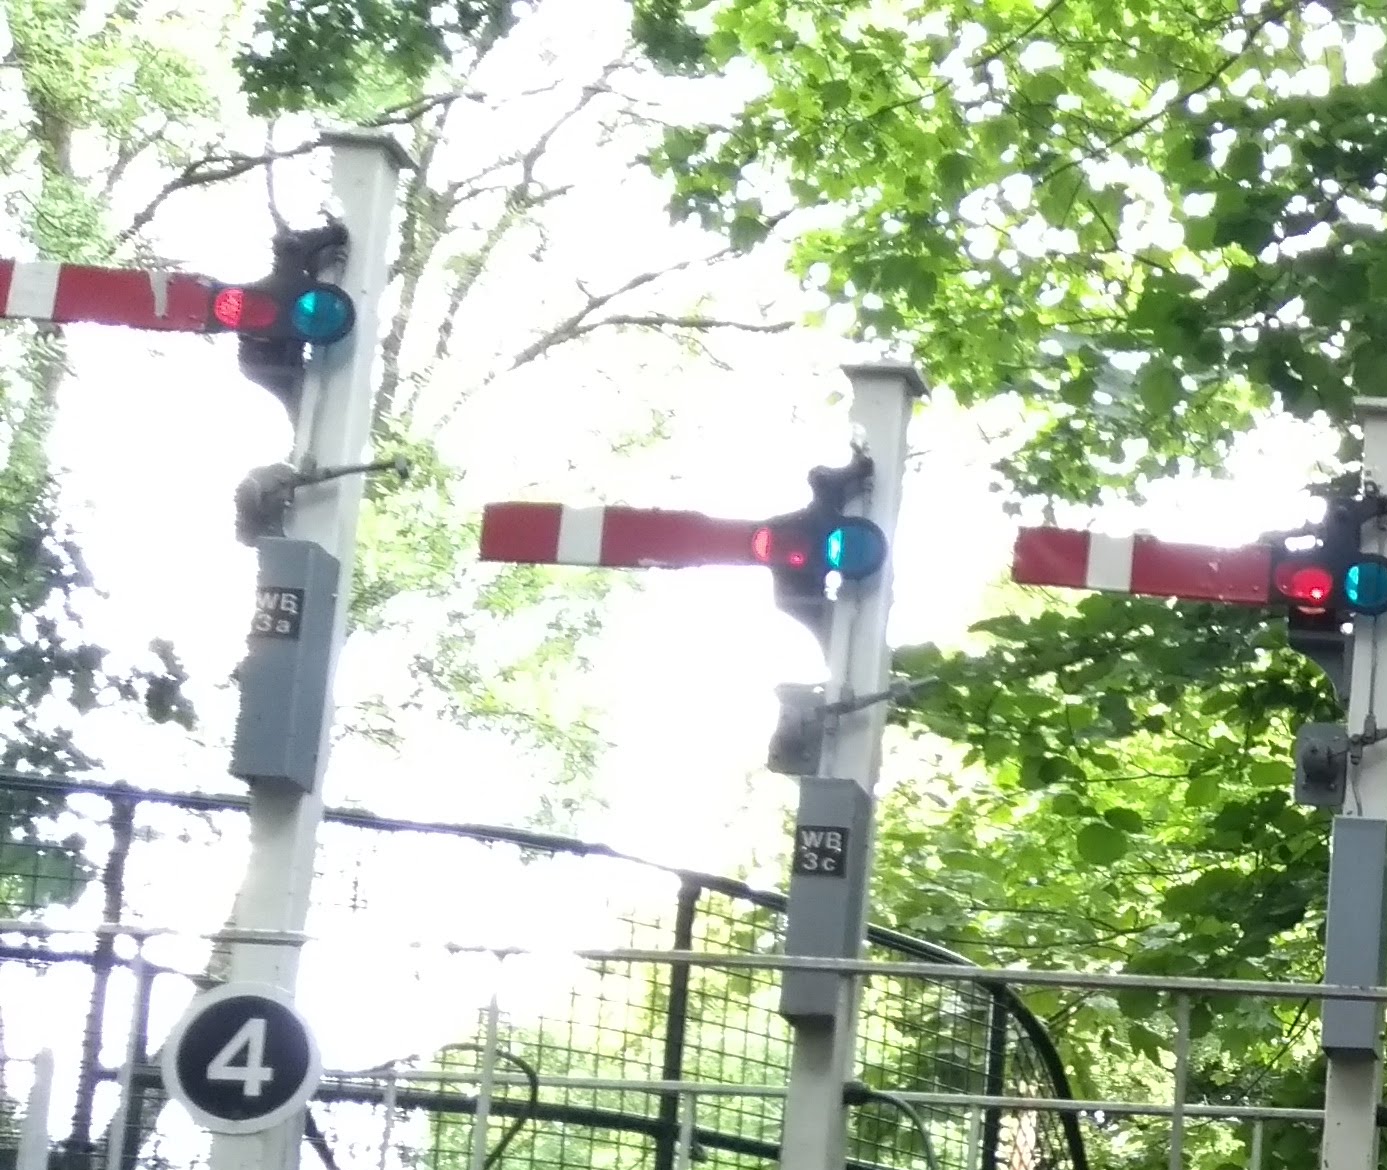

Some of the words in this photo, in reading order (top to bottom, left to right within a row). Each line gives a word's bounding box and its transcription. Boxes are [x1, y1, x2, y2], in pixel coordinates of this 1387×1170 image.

[801, 830, 842, 850] WB
[803, 852, 836, 871] 3c
[206, 1018, 274, 1097] 4
